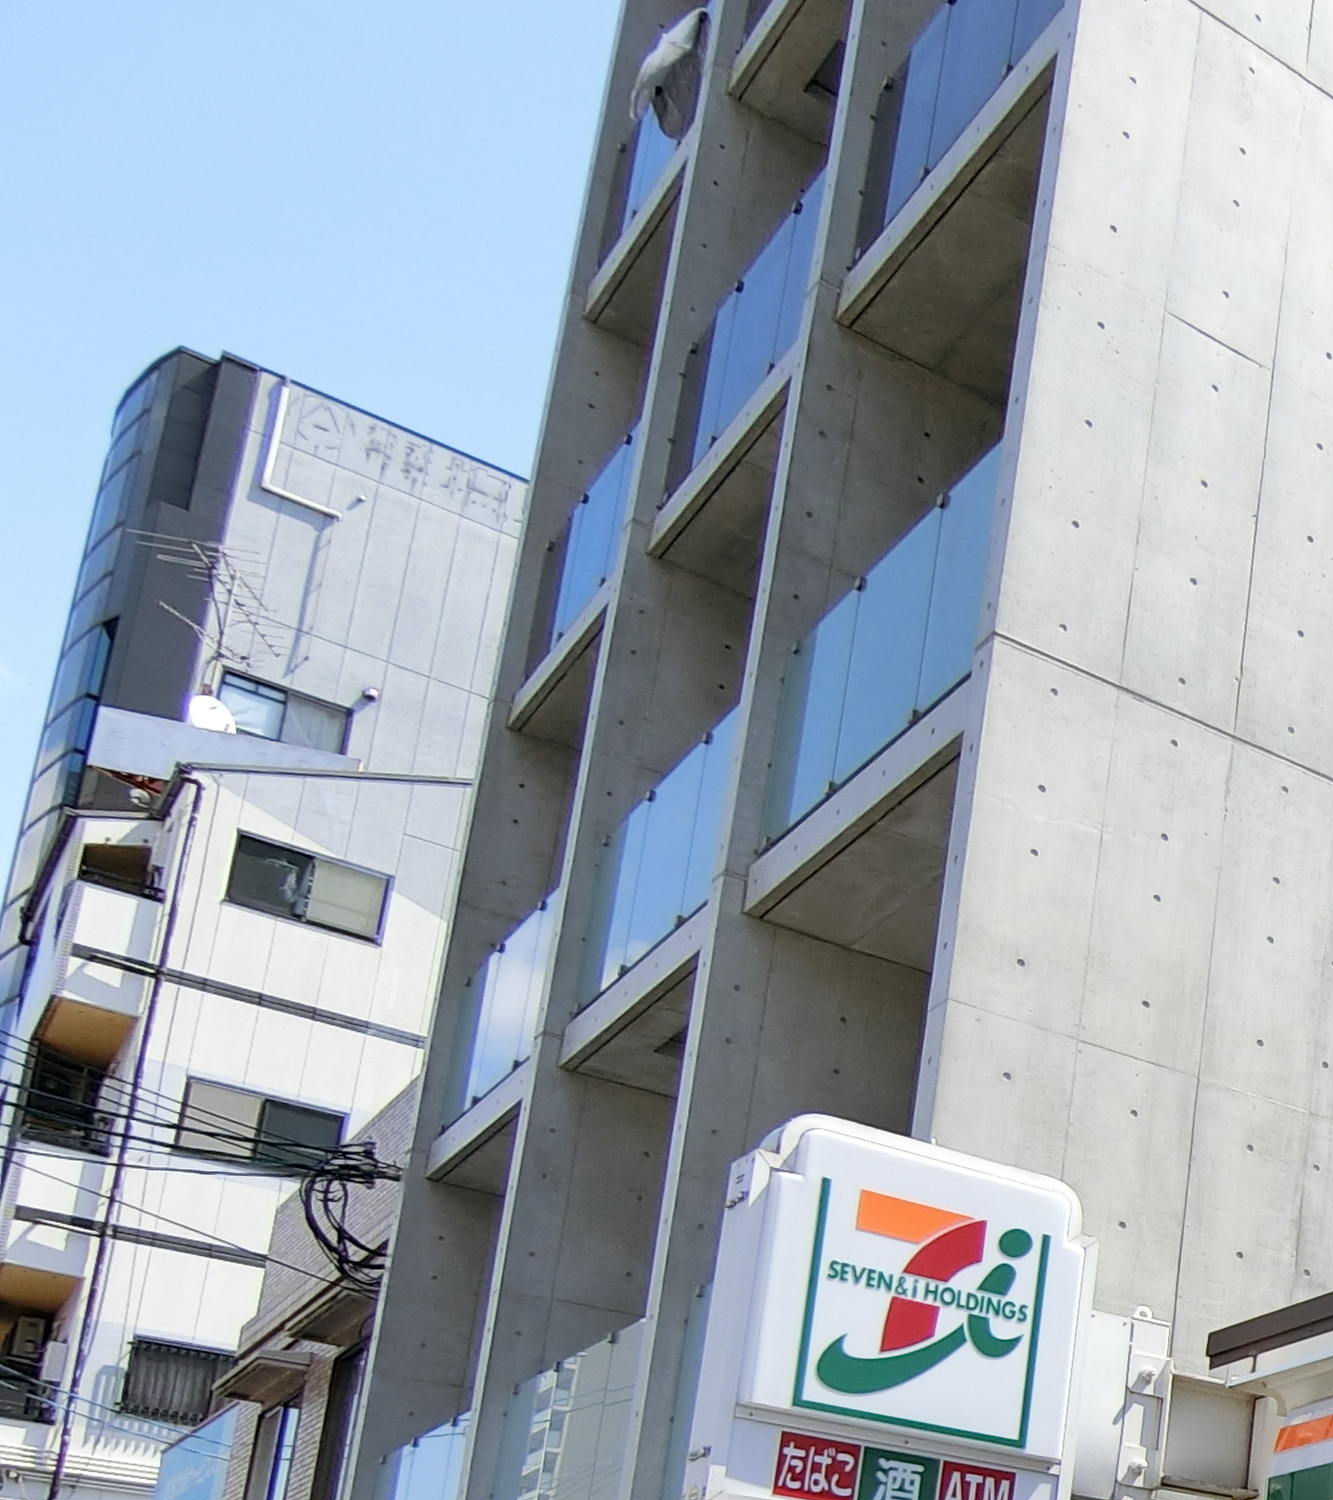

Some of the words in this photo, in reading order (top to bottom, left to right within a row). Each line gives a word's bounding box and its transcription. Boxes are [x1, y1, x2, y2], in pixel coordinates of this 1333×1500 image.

[924, 1285, 1028, 1322] HOLDINGS
[776, 1441, 853, 1496] たばこ
